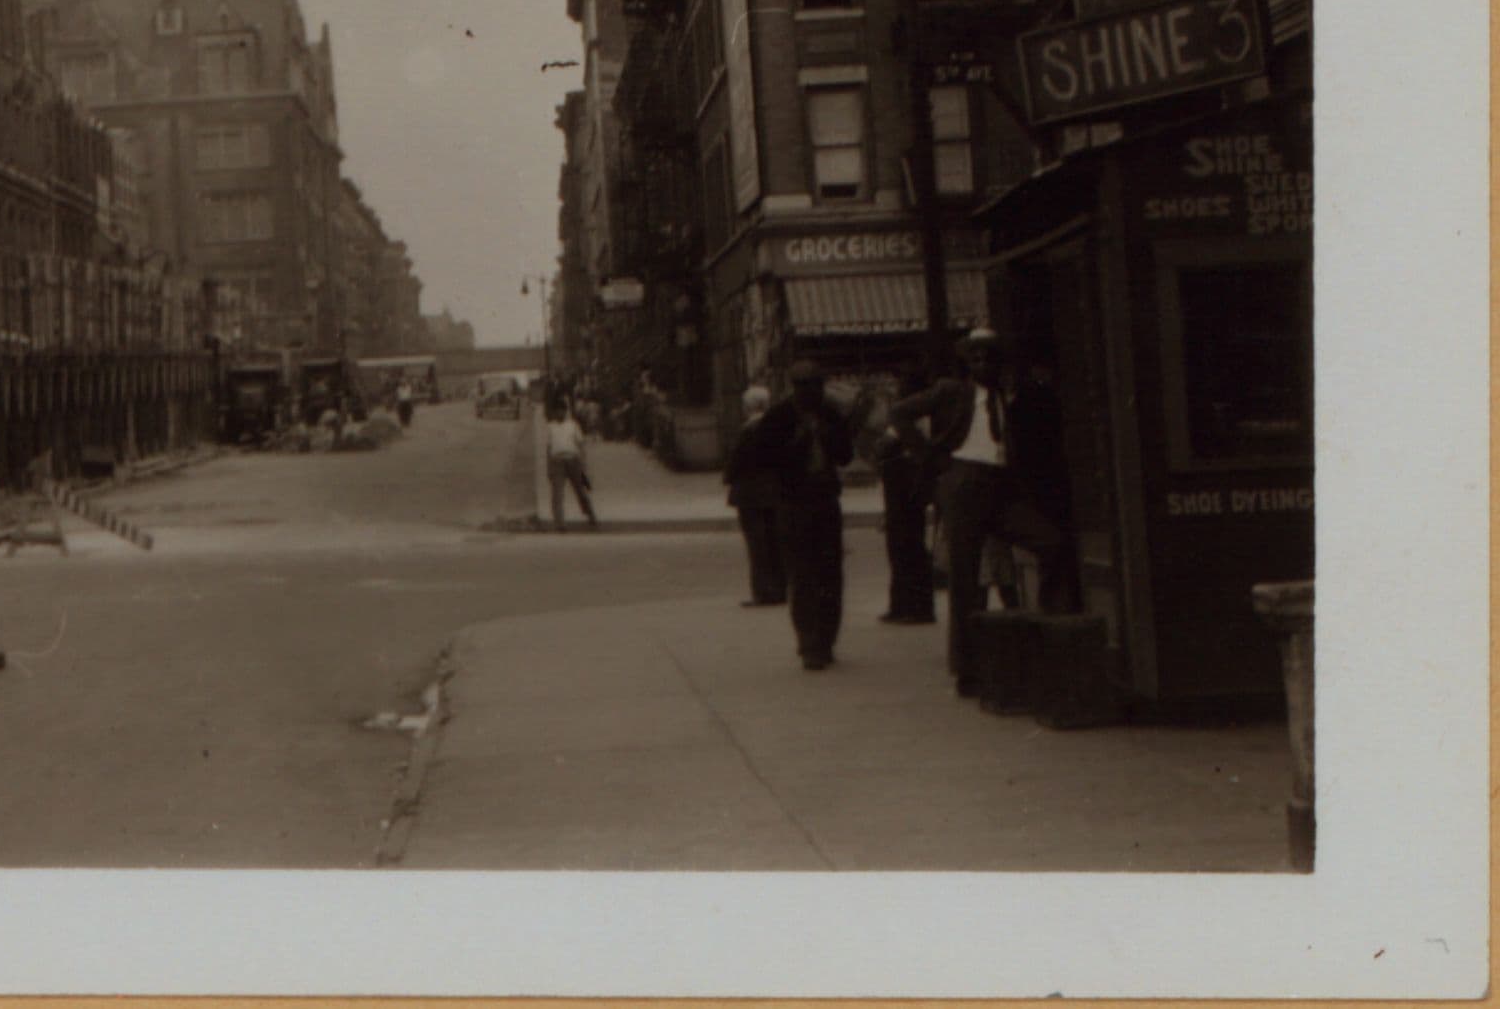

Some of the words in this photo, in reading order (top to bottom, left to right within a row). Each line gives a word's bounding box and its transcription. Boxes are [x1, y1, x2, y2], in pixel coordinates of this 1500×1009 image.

[1041, 8, 1205, 101] SHINE
[1144, 196, 1231, 219] SHOES
[785, 232, 915, 262] GROCERIES
[1167, 492, 1223, 515] SHOE
[1230, 489, 1312, 512] DYEING
